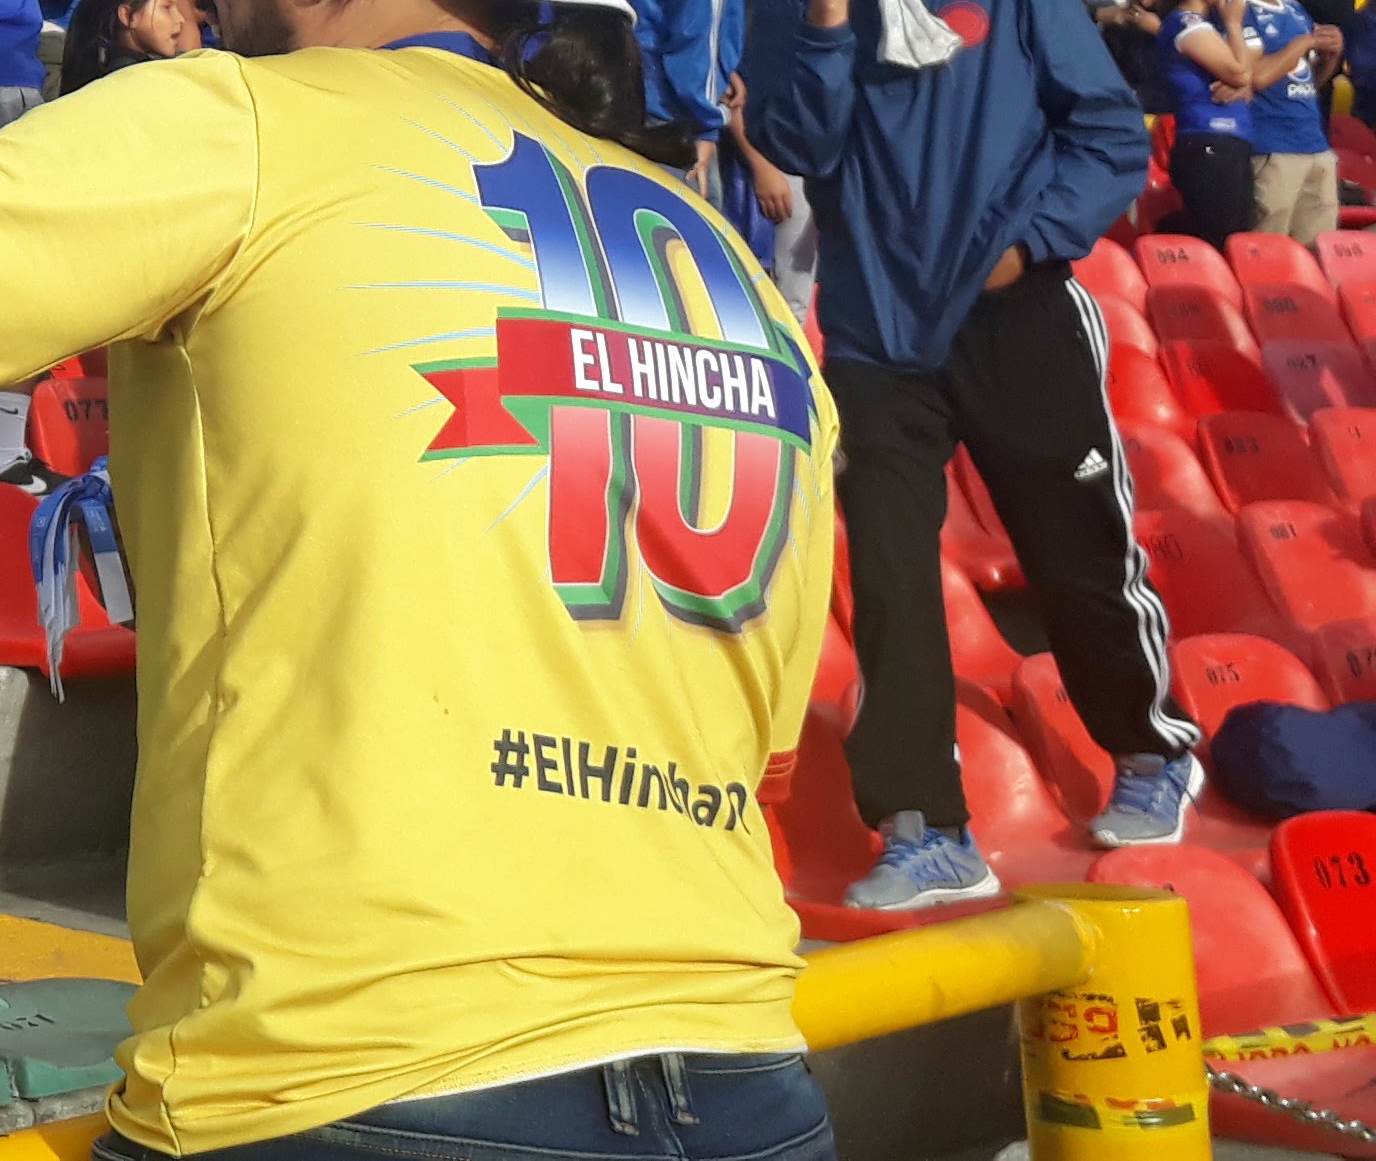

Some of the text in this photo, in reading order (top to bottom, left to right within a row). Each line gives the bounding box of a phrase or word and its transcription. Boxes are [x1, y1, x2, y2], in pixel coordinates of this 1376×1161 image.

[570, 329, 777, 420] EL HINCHA
[1313, 852, 1371, 890] 073
